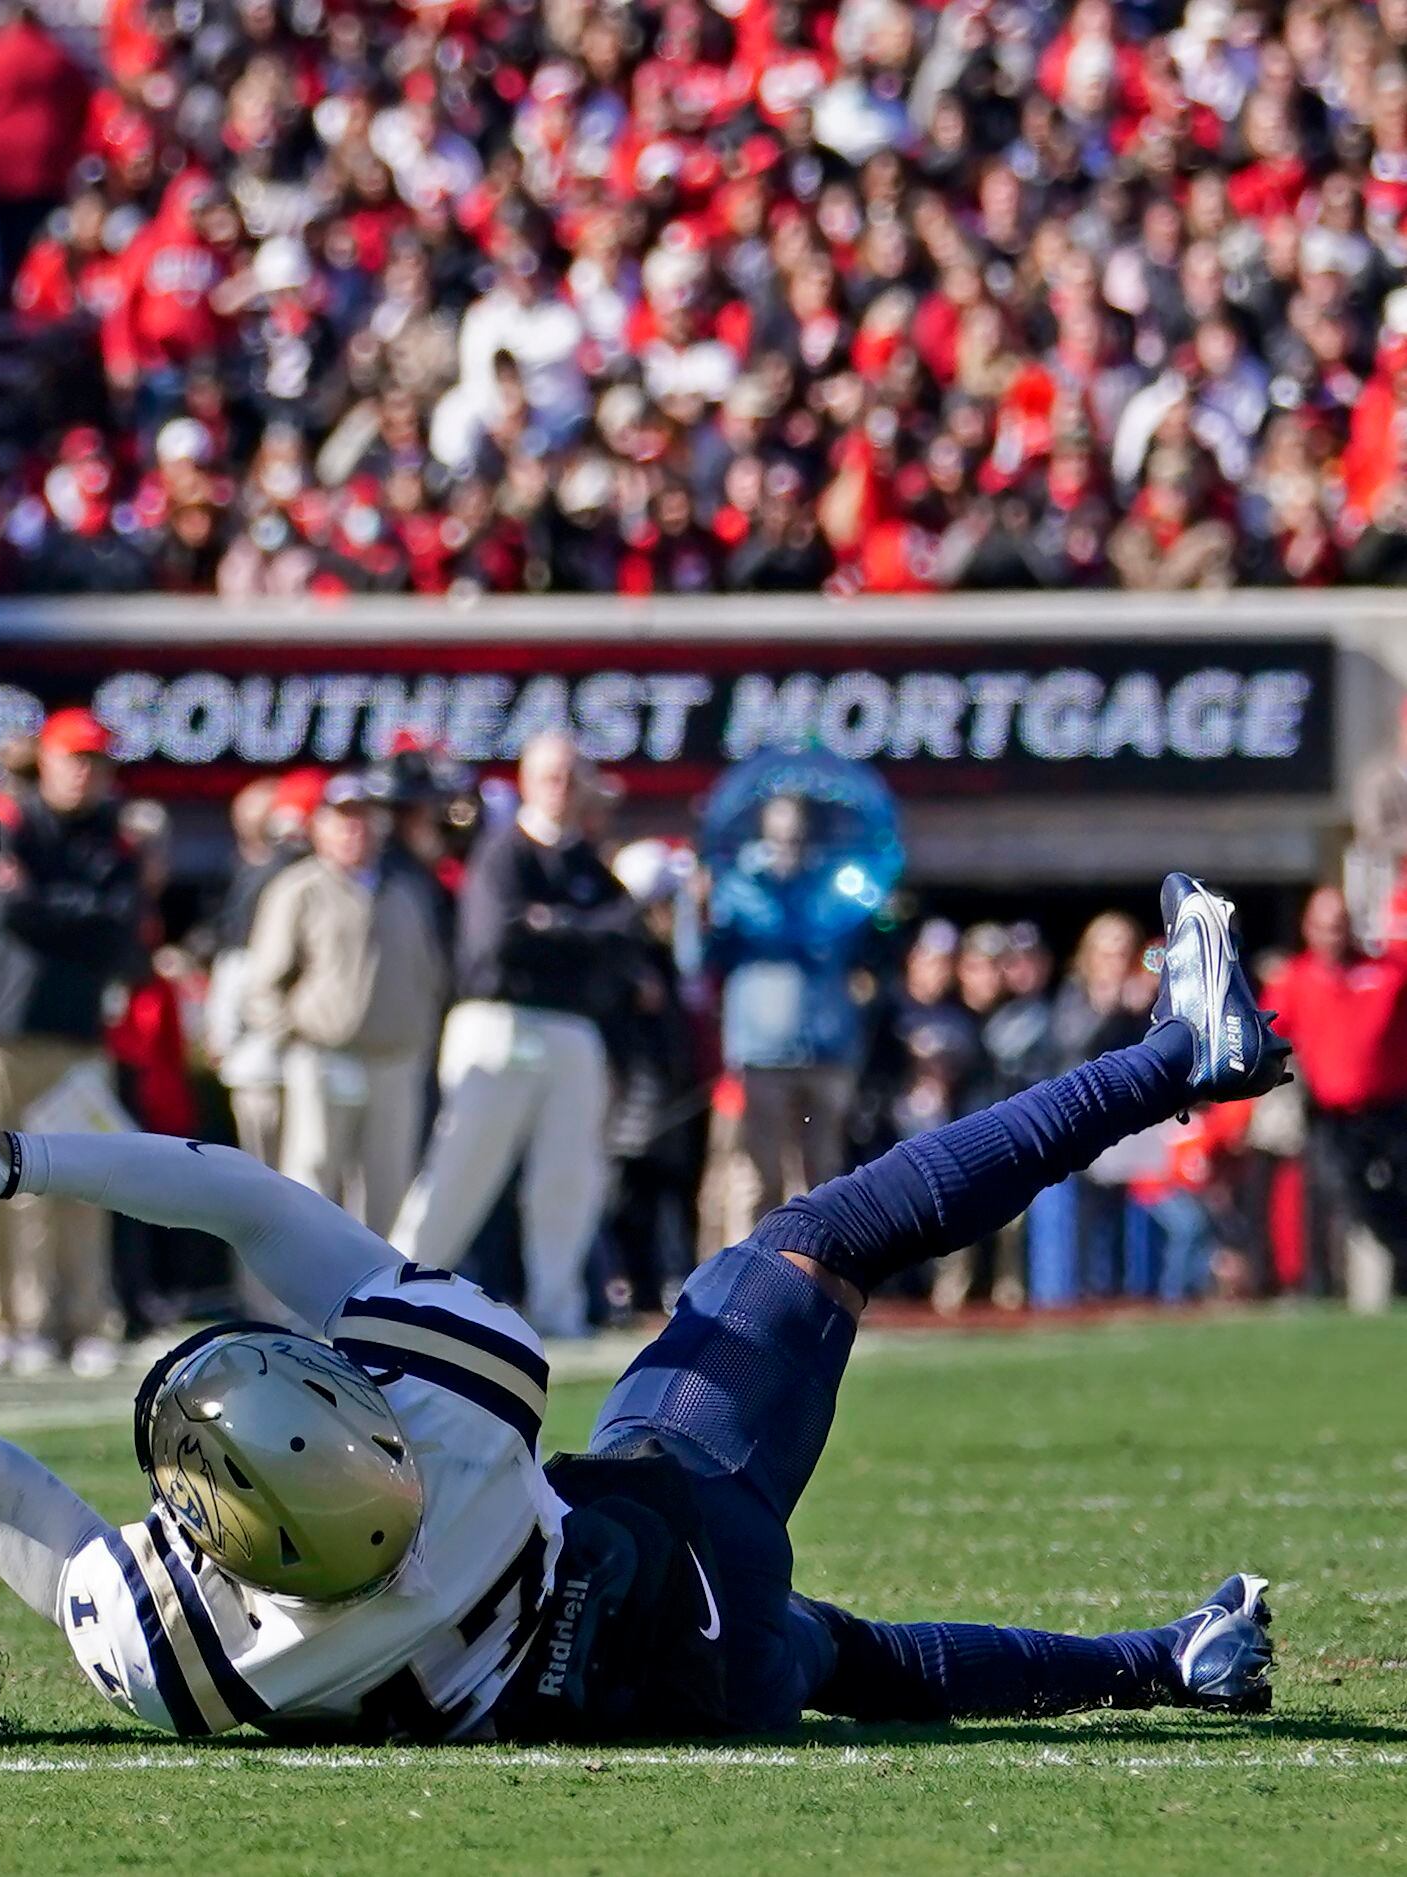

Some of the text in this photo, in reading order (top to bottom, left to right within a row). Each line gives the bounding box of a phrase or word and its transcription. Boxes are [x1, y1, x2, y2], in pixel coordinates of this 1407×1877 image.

[94, 667, 1311, 763] SOUTHEAST MORTGAGE
[538, 1579, 590, 1697] Riddell
